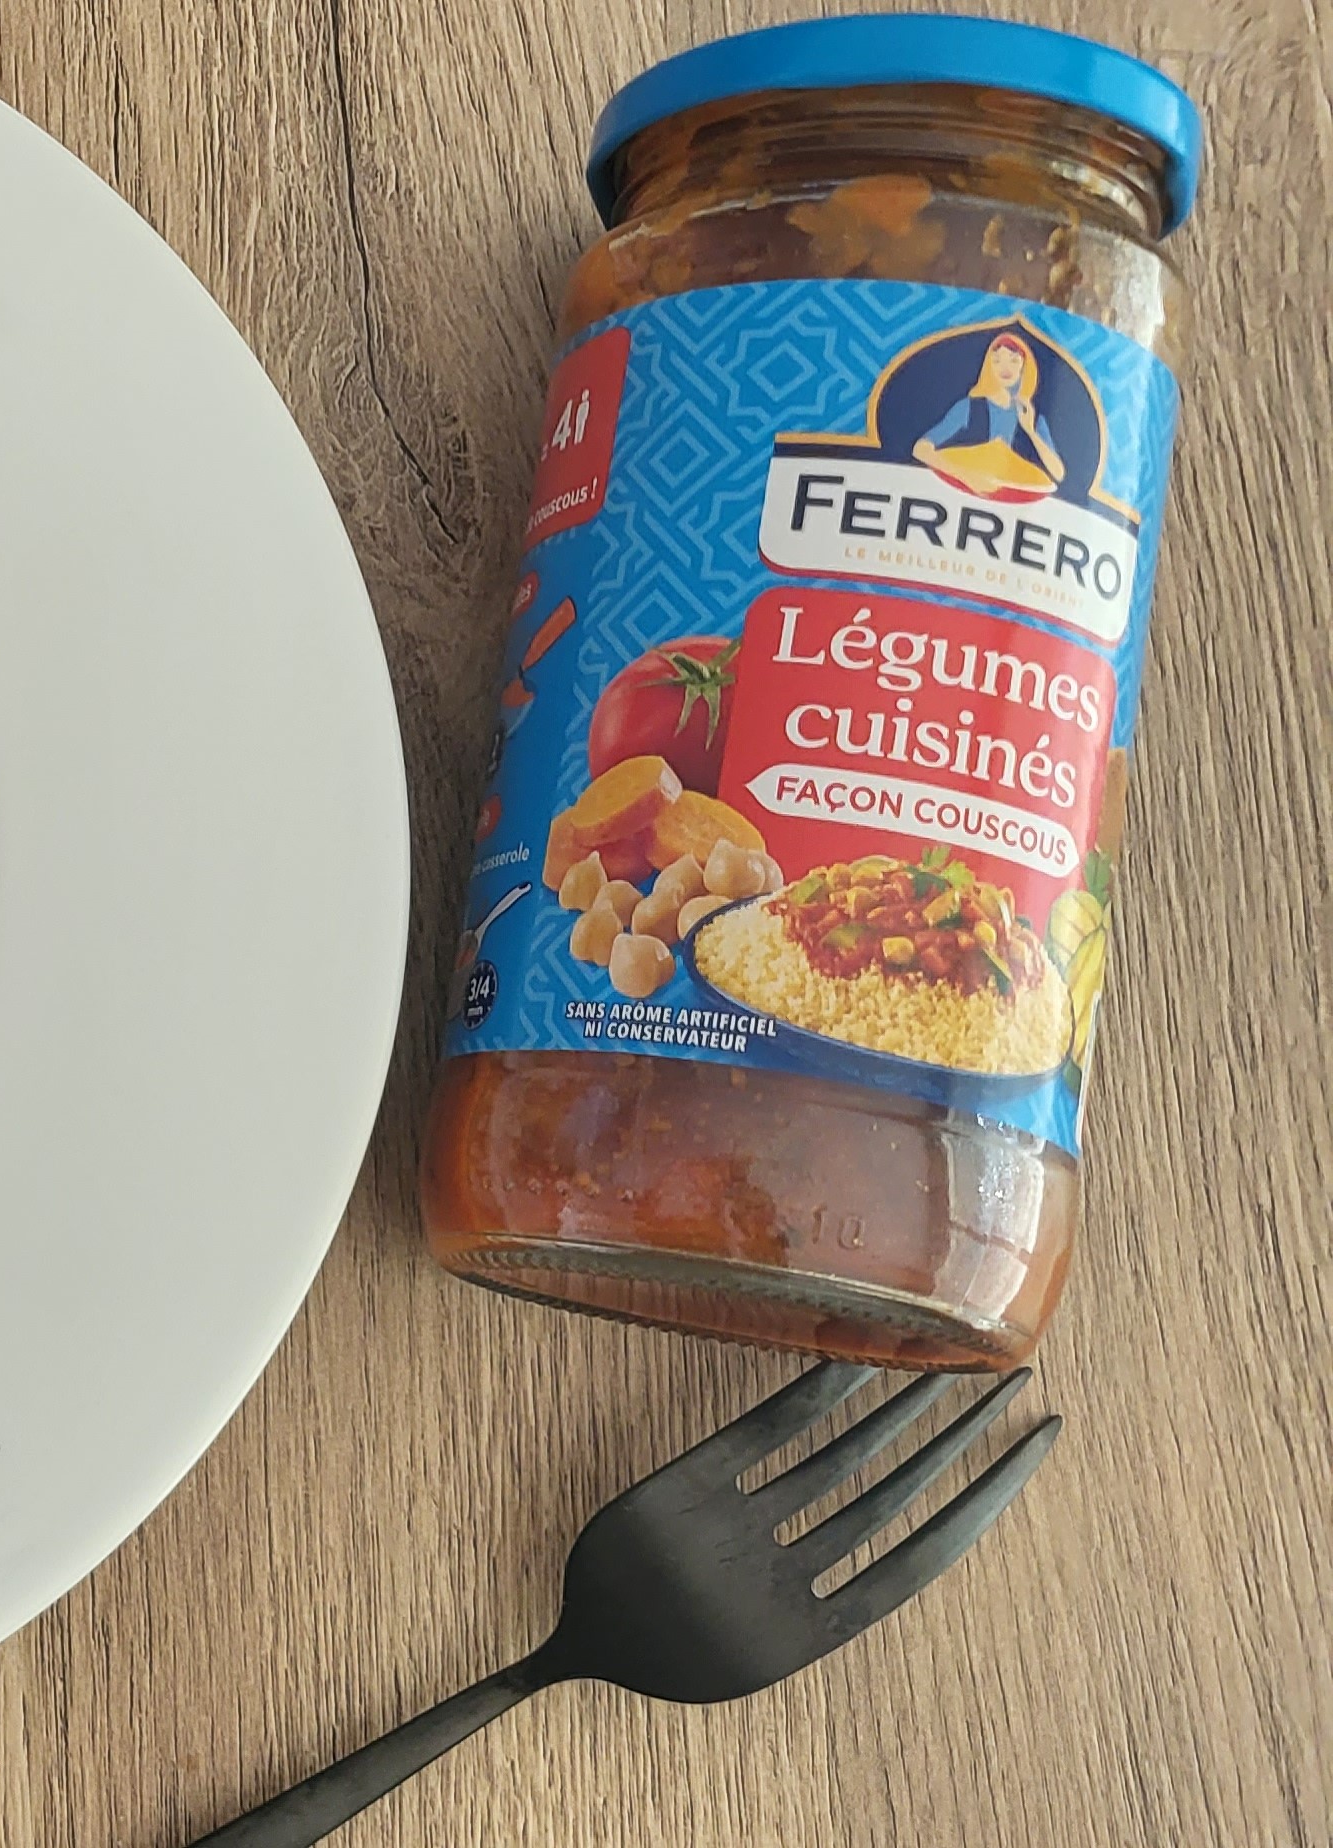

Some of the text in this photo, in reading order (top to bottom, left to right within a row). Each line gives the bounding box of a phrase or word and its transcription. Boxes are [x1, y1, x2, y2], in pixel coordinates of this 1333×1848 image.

[551, 399, 573, 450] 4
[790, 473, 1121, 600] FERRERO
[844, 546, 866, 559] LE
[878, 550, 975, 577] MEILLEUR
[985, 569, 1008, 584] DE
[772, 606, 1100, 733] Légumes
[785, 697, 1076, 809] cuisinés
[775, 775, 1067, 865] FAÇON COUSCOUS
[468, 975, 490, 1002] 3/4
[566, 1001, 777, 1037] SANS ARÔME ARTIFICIEL
[584, 1021, 747, 1053] NI CONSERVATEUR
